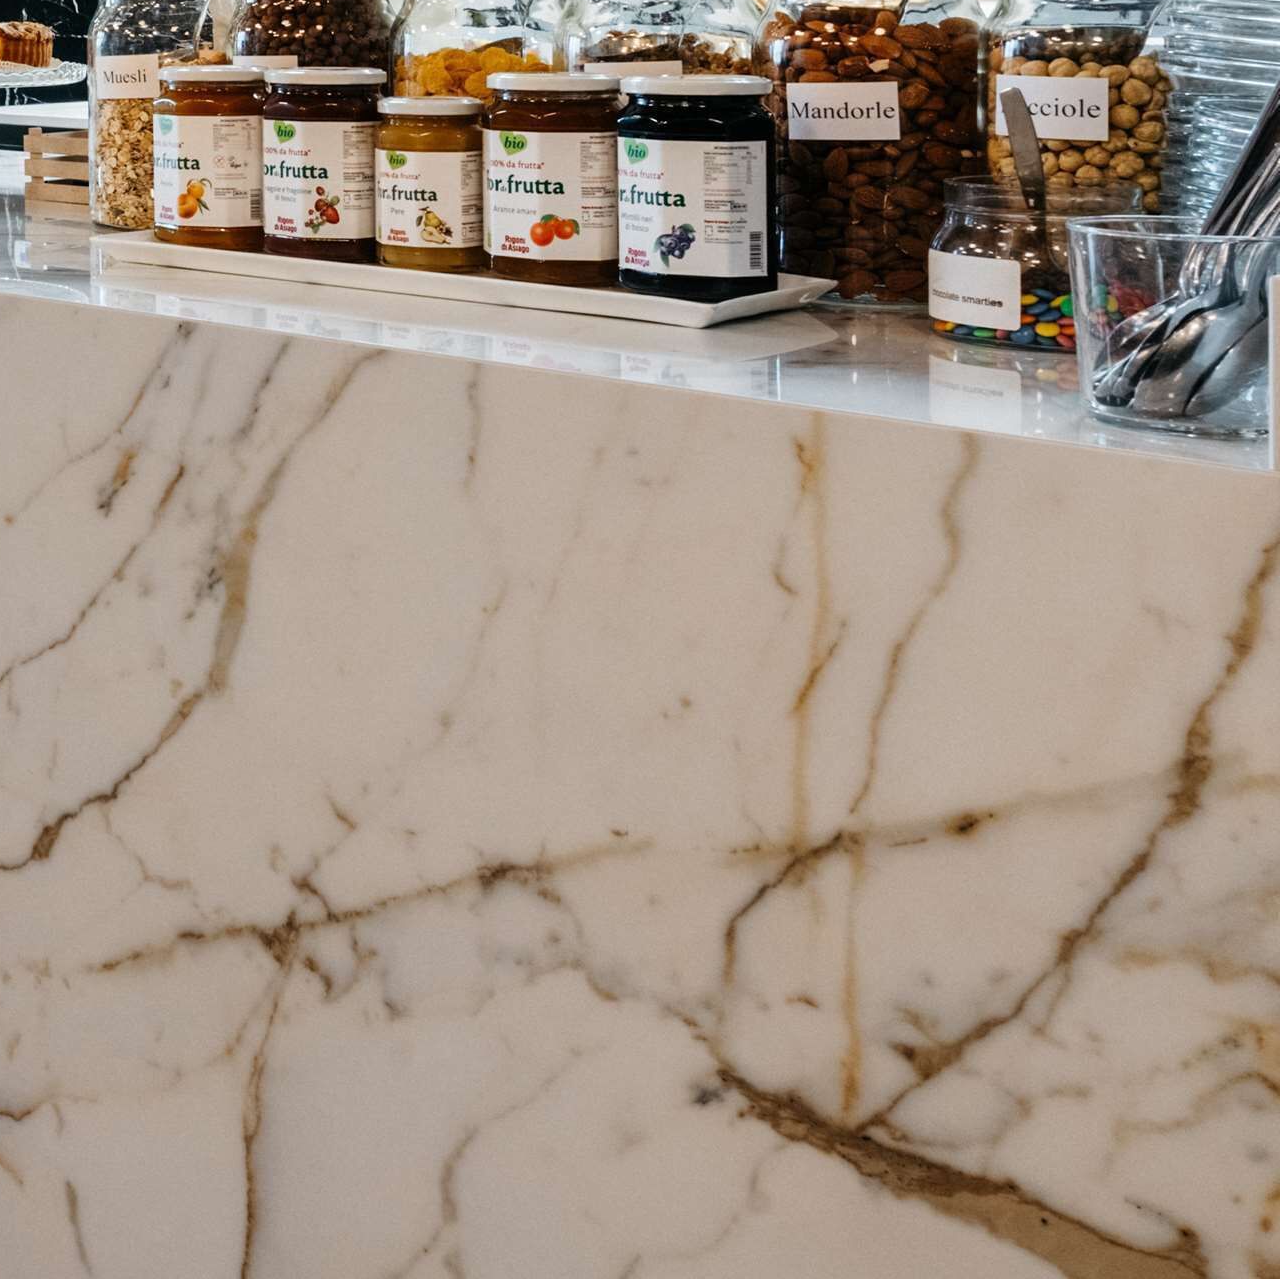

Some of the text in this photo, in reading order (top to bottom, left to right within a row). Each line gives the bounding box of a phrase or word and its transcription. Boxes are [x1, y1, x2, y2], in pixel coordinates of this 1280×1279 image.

[103, 69, 147, 84] Muesli
[791, 102, 895, 120] Mandorle
[1028, 98, 1101, 119] cciole
[277, 126, 294, 138] bio
[504, 136, 525, 149] bio
[627, 145, 646, 158] bio
[389, 155, 406, 165] bio
[505, 235, 526, 245] Rigoni
[508, 244, 530, 254] Asiago
[961, 295, 1003, 308] smarties
